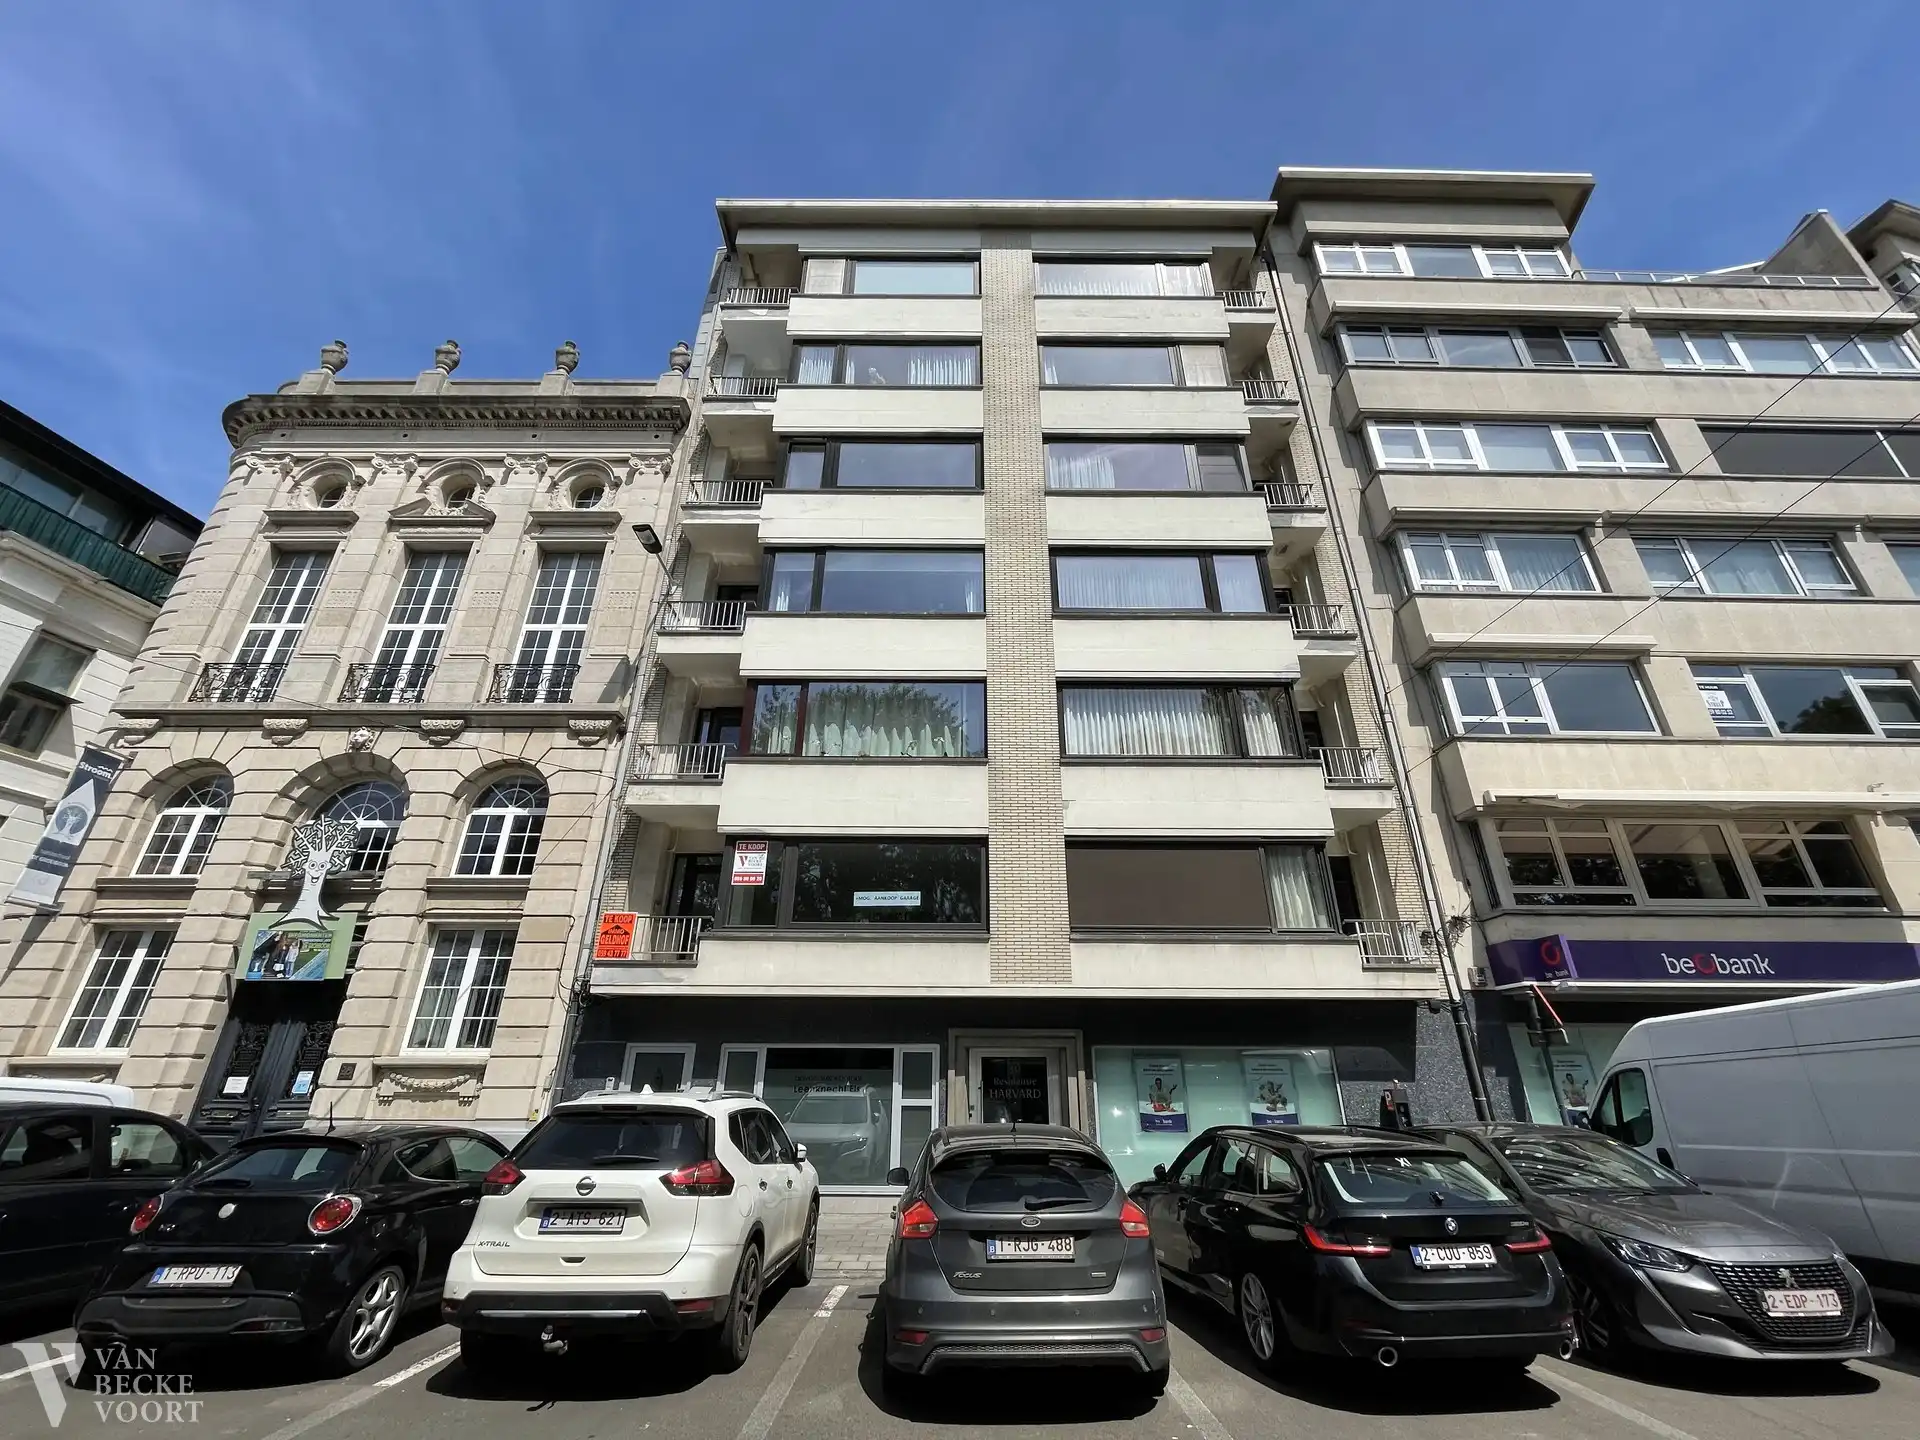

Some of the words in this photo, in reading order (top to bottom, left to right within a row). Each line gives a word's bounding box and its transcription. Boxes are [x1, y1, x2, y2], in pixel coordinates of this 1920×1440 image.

[604, 914, 614, 923] TE
[614, 914, 633, 923] KOOP
[600, 934, 630, 945] GELDHOF
[614, 949, 621, 957] 77
[621, 949, 628, 957] 77
[989, 1088, 1042, 1099] HARVARD
[550, 1211, 623, 1227] 2-ATS-621
[989, 1245, 995, 1253] B
[999, 1236, 1073, 1253] 1-RJG-488
[1767, 1293, 1839, 1309] 2-EDP-173
